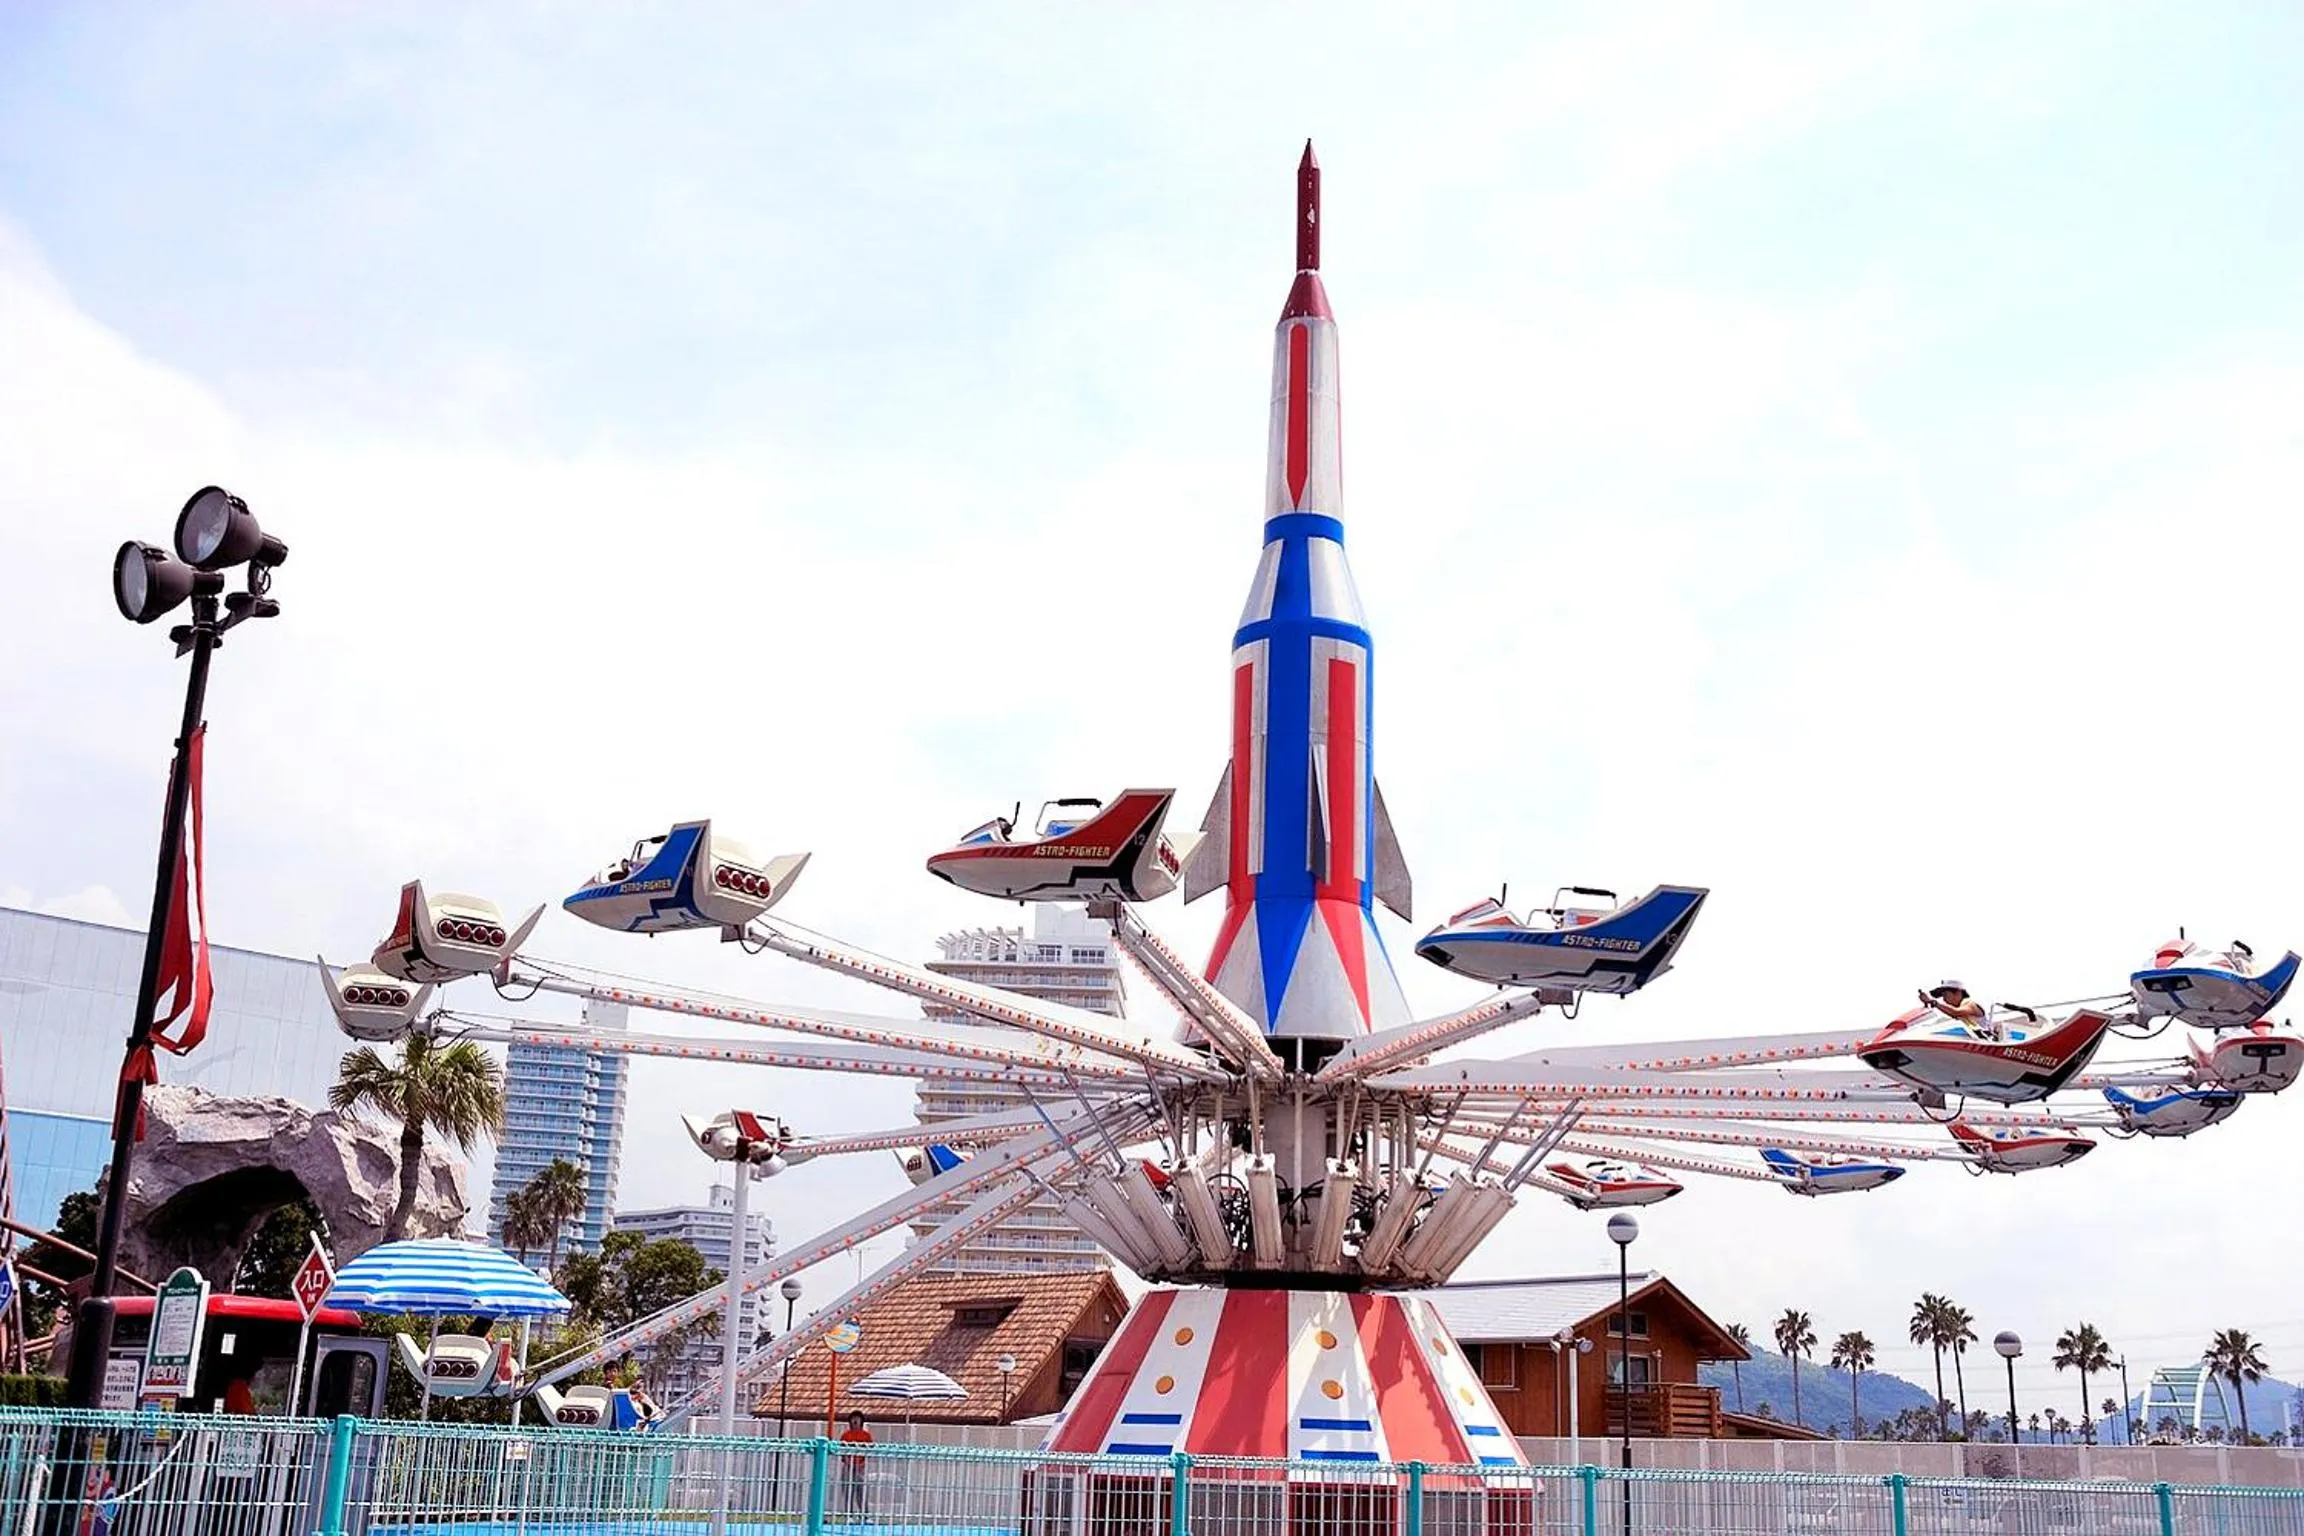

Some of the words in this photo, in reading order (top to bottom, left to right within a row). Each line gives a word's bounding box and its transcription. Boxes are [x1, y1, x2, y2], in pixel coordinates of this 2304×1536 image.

[1032, 846, 1111, 857] ASTRO-FIGHTER
[1562, 934, 1641, 951] ASTRO-FIGHTER
[300, 1270, 325, 1292] 入口
